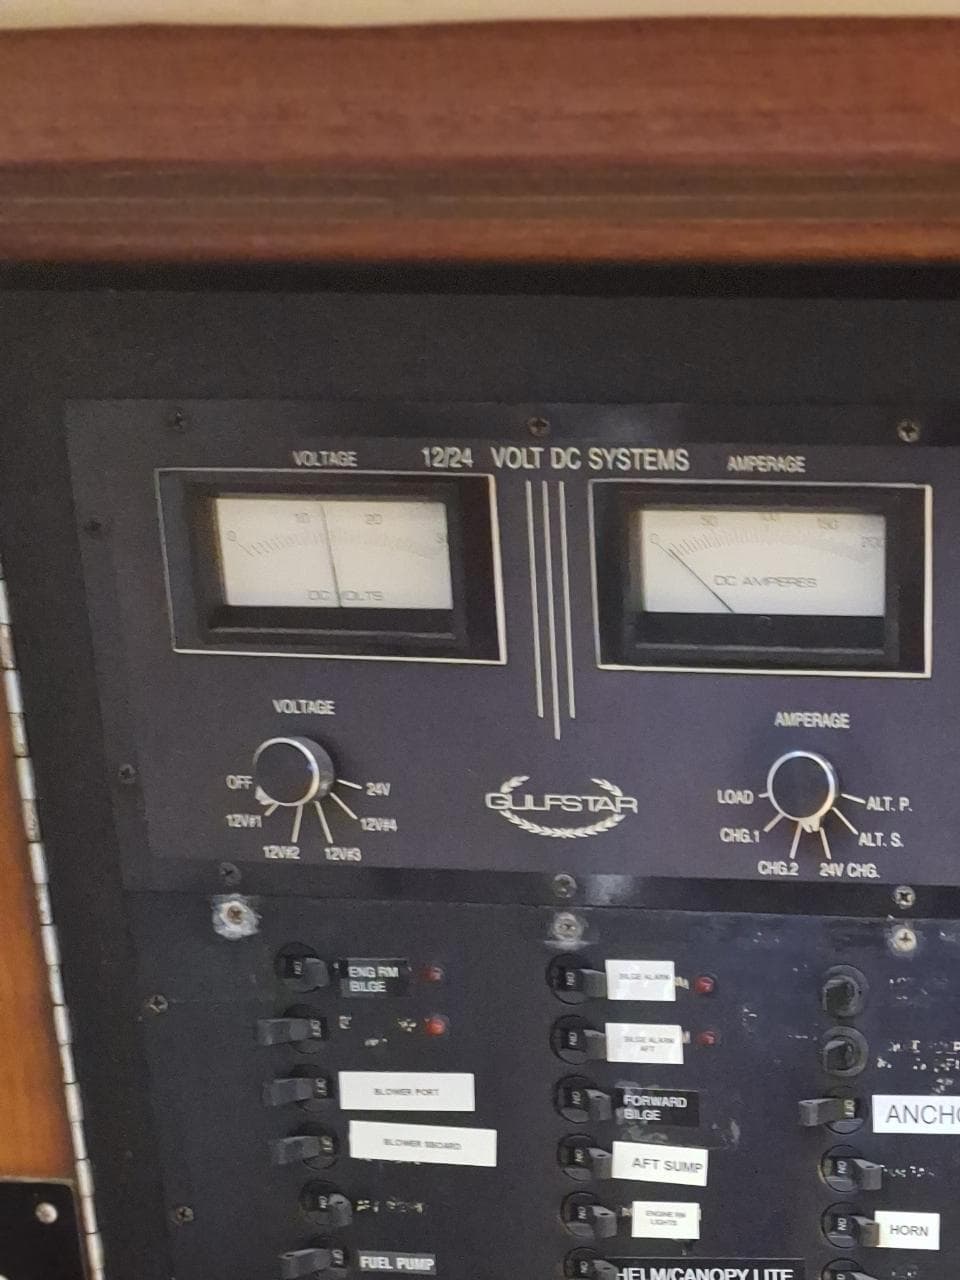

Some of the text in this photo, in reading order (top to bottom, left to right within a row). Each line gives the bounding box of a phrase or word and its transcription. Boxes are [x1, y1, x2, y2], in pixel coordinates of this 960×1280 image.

[293, 451, 357, 466] VOLTAGE
[422, 447, 689, 472] 12/24 VOLT DC SYSTEMS
[727, 456, 806, 473] AMPERAGE
[273, 699, 335, 715] VOLTAGE
[775, 713, 850, 728] AMPERAGE
[227, 776, 252, 789] OFF
[366, 783, 390, 796] 24V
[486, 793, 638, 813] GULFSTAR
[718, 790, 753, 804] LOAD
[867, 797, 912, 811] ALT. P.
[226, 814, 262, 829] 12V#1
[720, 829, 760, 843] CHG.1
[858, 833, 904, 848] ALT. S.
[758, 861, 798, 876] CHG.2
[820, 862, 880, 878] 24V CHG.
[348, 966, 399, 978] ENG RM
[351, 981, 386, 993] BILGE
[623, 1095, 688, 1109] FORWARD
[624, 1109, 661, 1121] BILGE
[632, 1158, 703, 1173] AFT SUMP
[890, 1224, 928, 1237] HORN
[359, 1255, 435, 1271] FUEL PUMP
